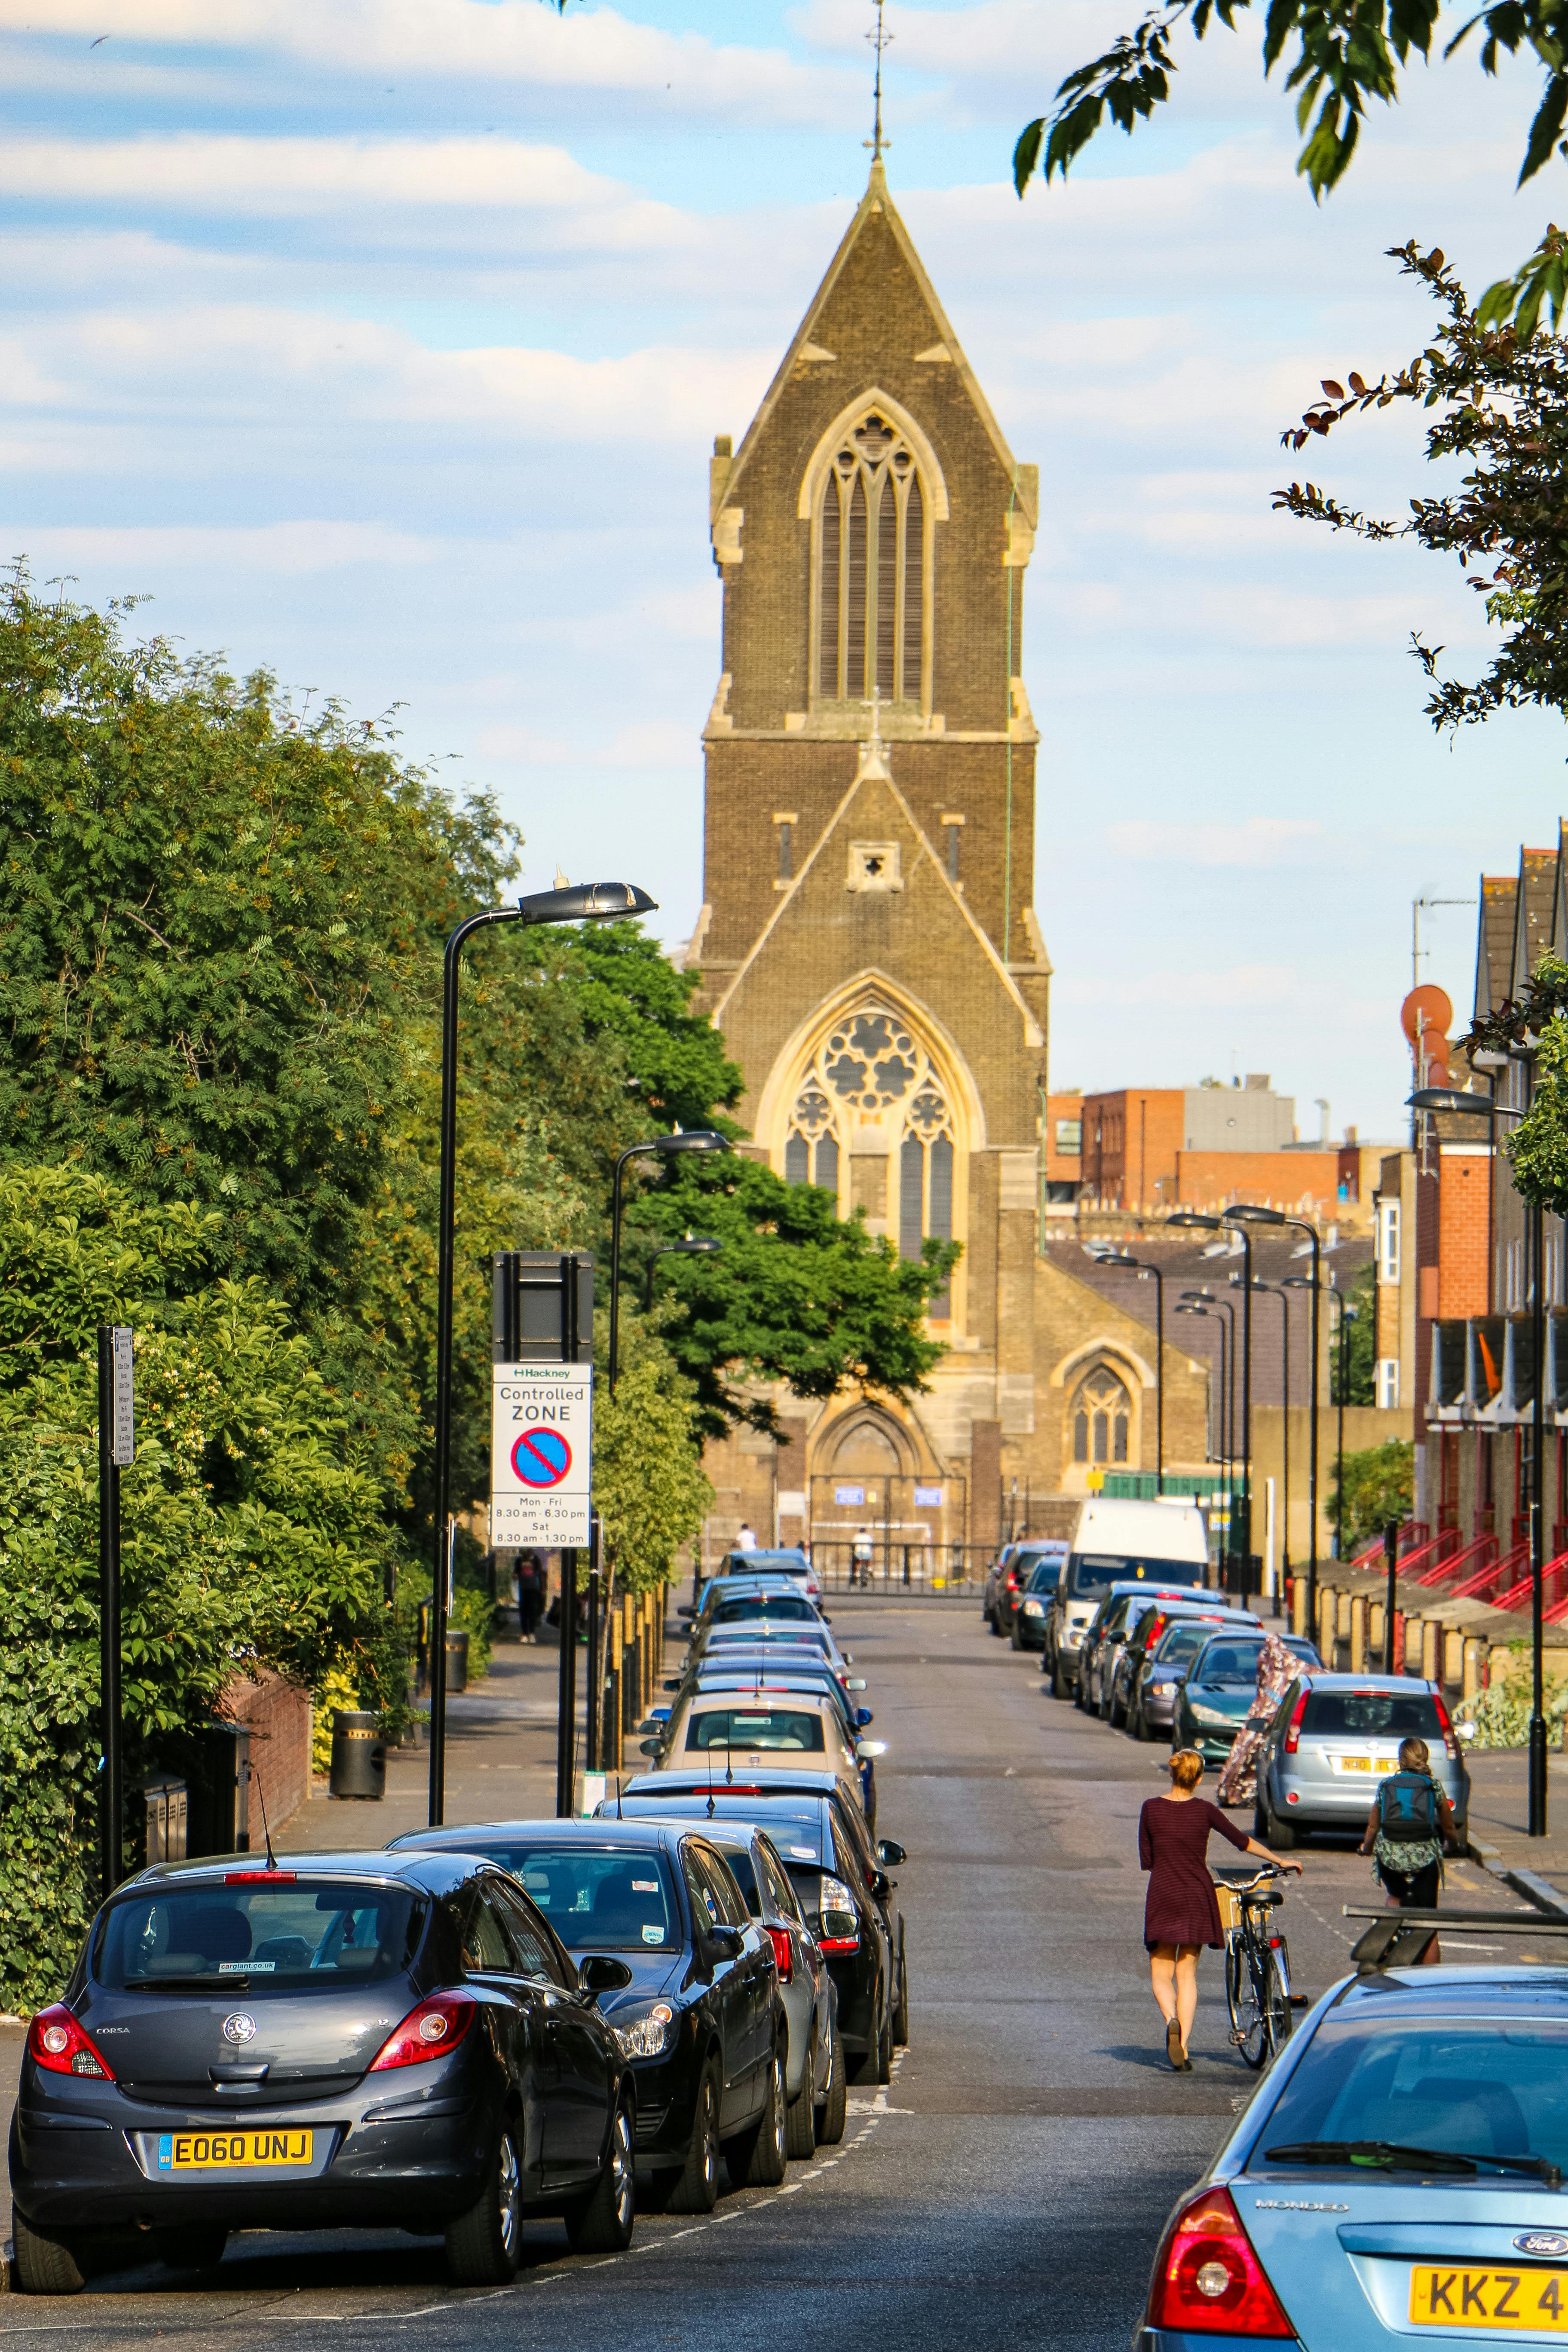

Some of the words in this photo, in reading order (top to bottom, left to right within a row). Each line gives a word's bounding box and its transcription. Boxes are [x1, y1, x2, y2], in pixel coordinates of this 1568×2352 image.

[526, 1369, 570, 1378] Hackney
[501, 1387, 584, 1400] Controlled
[512, 1406, 570, 1421] ZONE
[496, 1509, 519, 1517] 8.30
[545, 1509, 568, 1518] 6.30
[497, 1534, 521, 1542] 8.30
[545, 1534, 567, 1542] 1.30
[176, 2137, 245, 2162] EO60
[254, 2134, 306, 2160] UNJ
[1255, 2198, 1349, 2213] MONDEO
[1526, 2236, 1560, 2251] Ford
[1430, 2273, 1520, 2318] KKZ
[1537, 2278, 1564, 2320] 4
